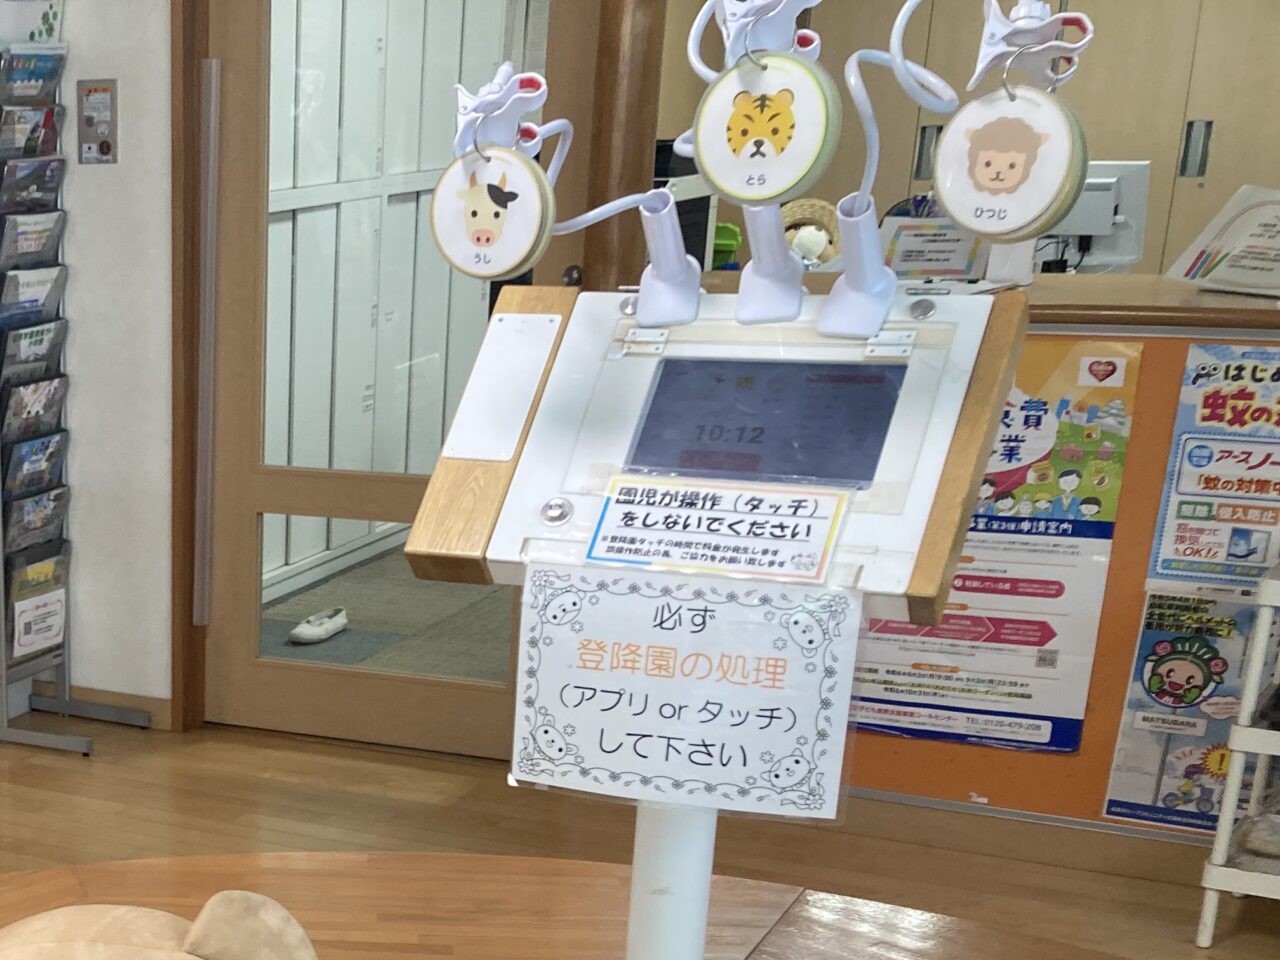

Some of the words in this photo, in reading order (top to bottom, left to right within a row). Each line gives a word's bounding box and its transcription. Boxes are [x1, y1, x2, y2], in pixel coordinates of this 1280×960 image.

[745, 172, 767, 186] とら
[974, 207, 1008, 221] ひつじ
[472, 252, 492, 265] うし
[1201, 386, 1280, 428] 蚊の
[694, 424, 766, 445] 10:12
[620, 510, 812, 539] をしないでください
[652, 602, 717, 634] 必ず
[576, 638, 789, 690] 登降園の処理
[659, 701, 690, 721] or
[599, 727, 748, 768] して下さい
